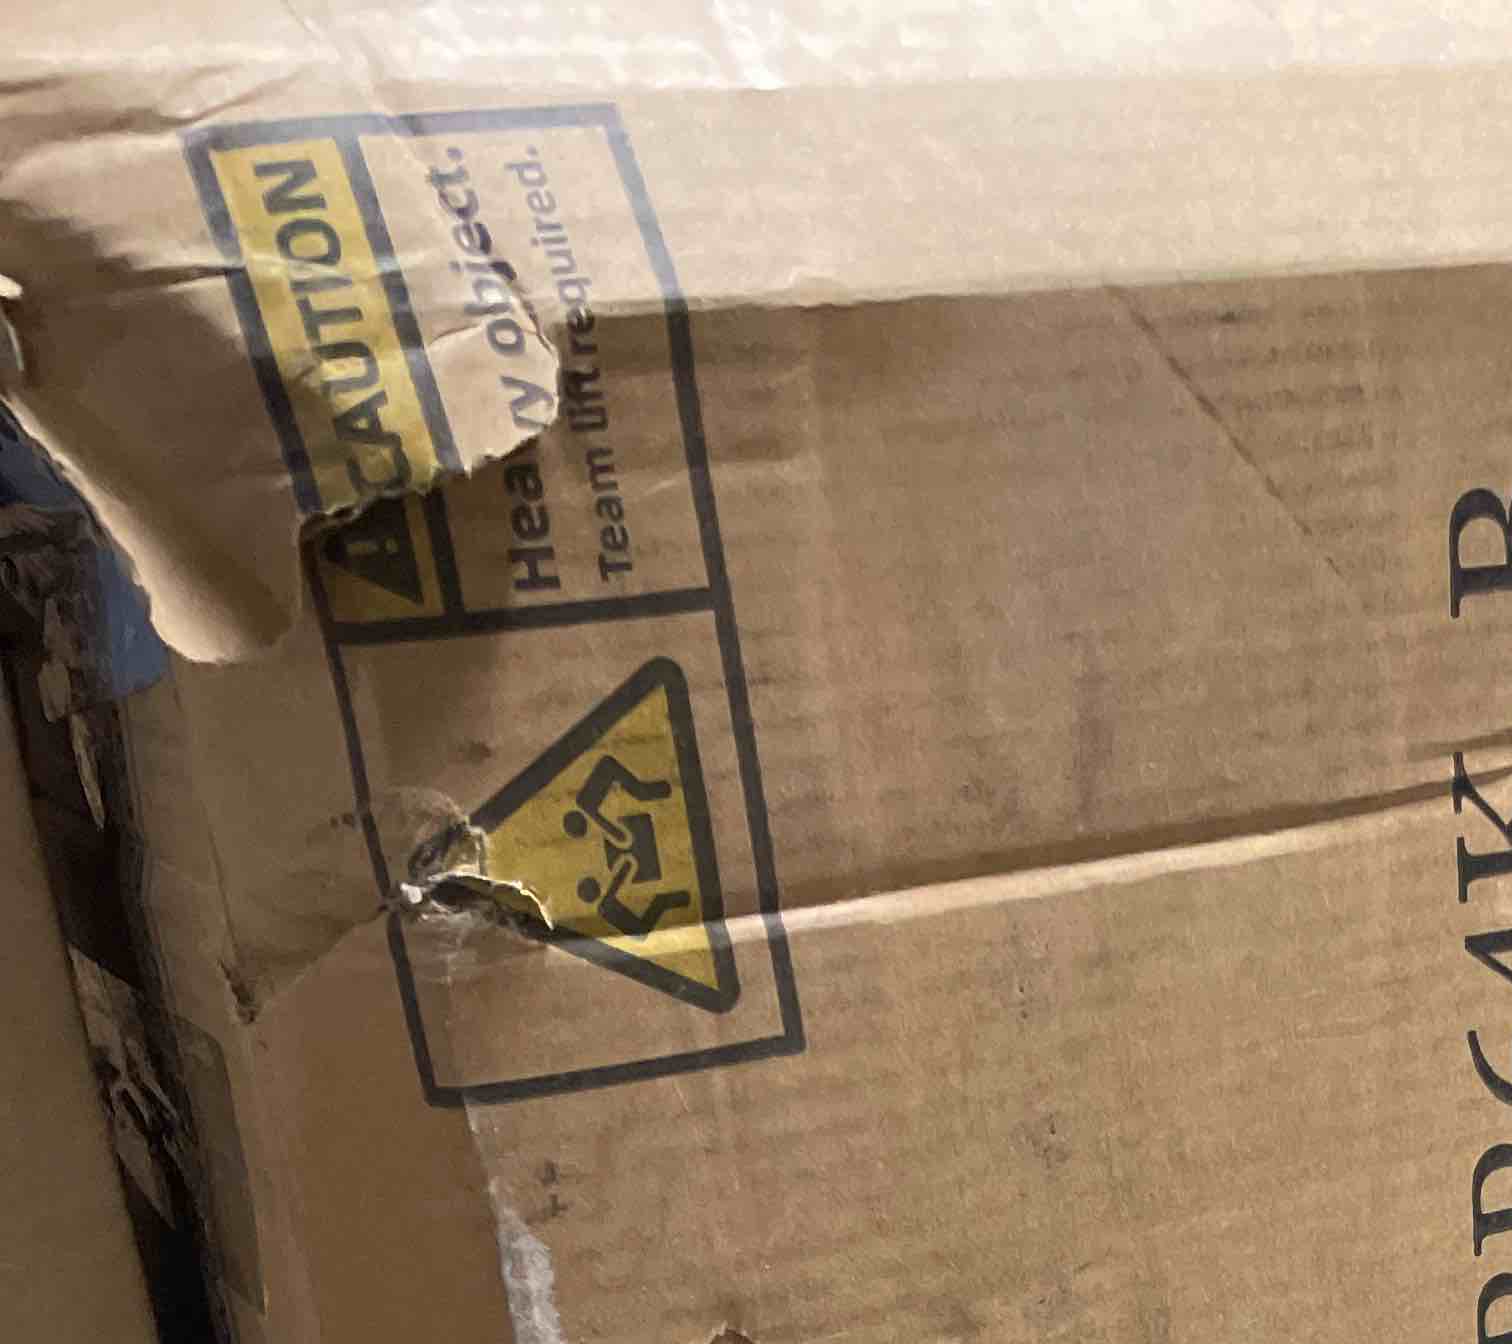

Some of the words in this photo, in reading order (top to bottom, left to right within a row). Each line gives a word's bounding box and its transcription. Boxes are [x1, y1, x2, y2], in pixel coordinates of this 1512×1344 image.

[253, 158, 412, 493] CAUTION
[427, 146, 526, 357] object.
[506, 145, 598, 361] required.
[567, 371, 610, 434] lift
[584, 447, 633, 582] Team
